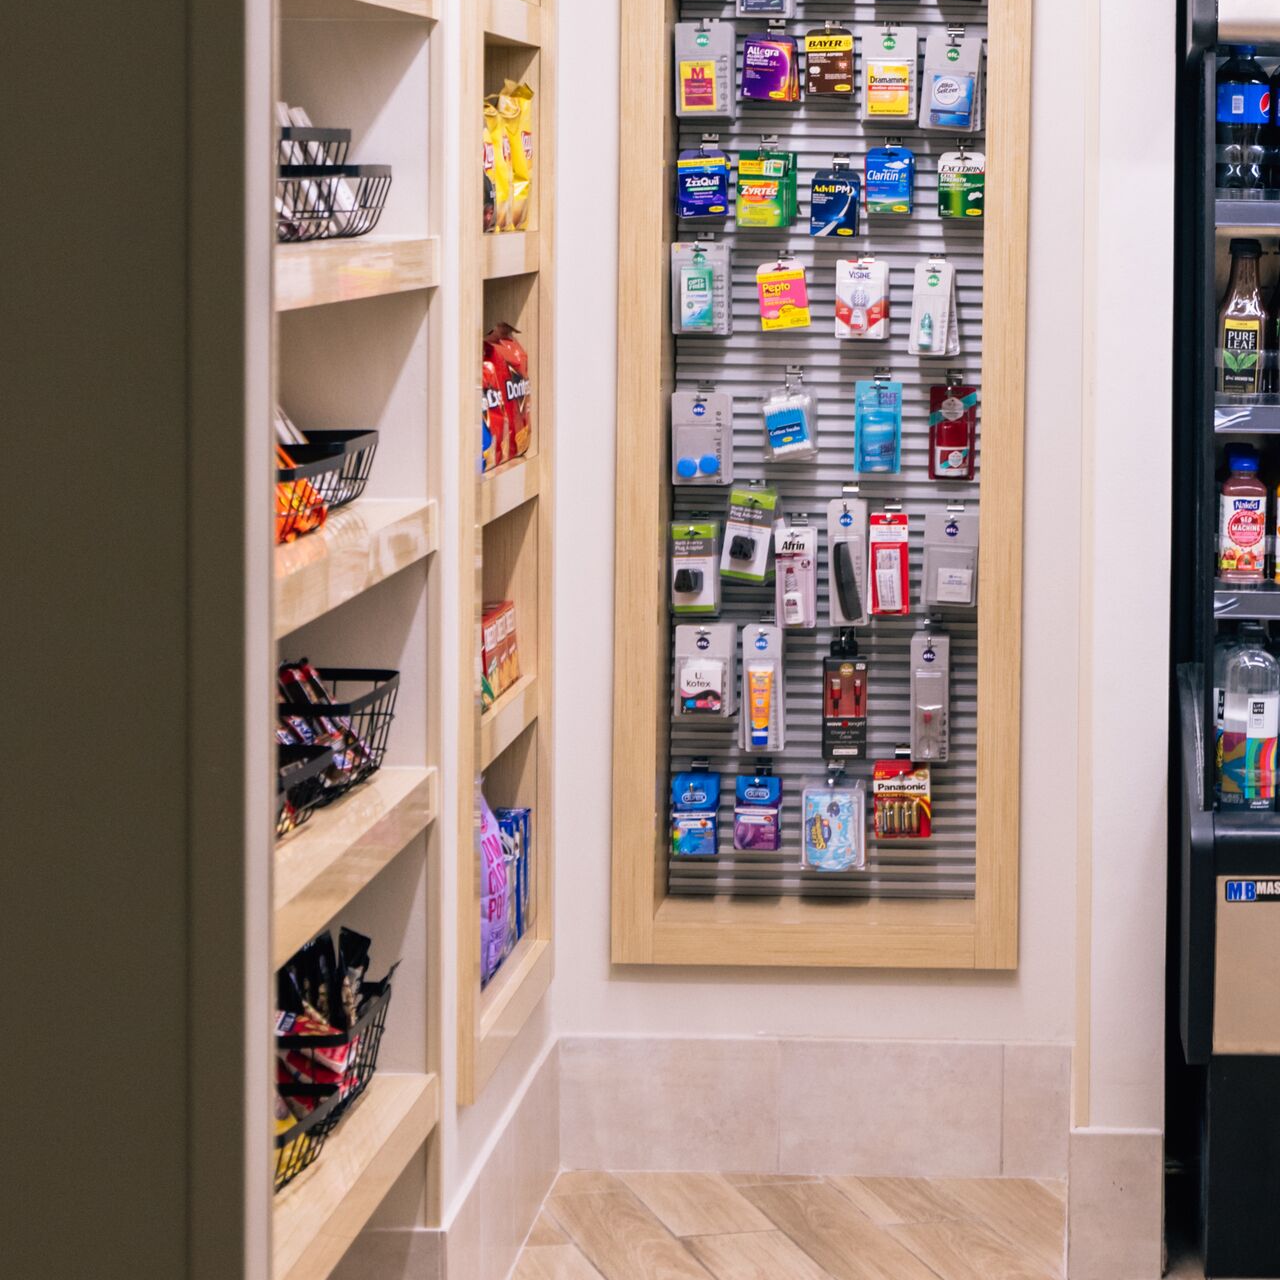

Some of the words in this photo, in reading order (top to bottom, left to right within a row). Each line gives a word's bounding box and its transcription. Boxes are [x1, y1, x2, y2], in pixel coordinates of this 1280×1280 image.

[747, 46, 779, 57] Allegra
[869, 76, 907, 84] Dramamine
[867, 169, 899, 181] Claritin
[813, 185, 835, 193] Advil
[835, 185, 850, 193] PM
[762, 283, 791, 294] Pepto
[1228, 330, 1255, 340] PURE
[1227, 340, 1255, 350] LEAF
[1231, 523, 1260, 532] MACHINE
[781, 541, 805, 551] Afrin
[687, 680, 711, 688] Kotex
[877, 783, 926, 791] Panasonic
